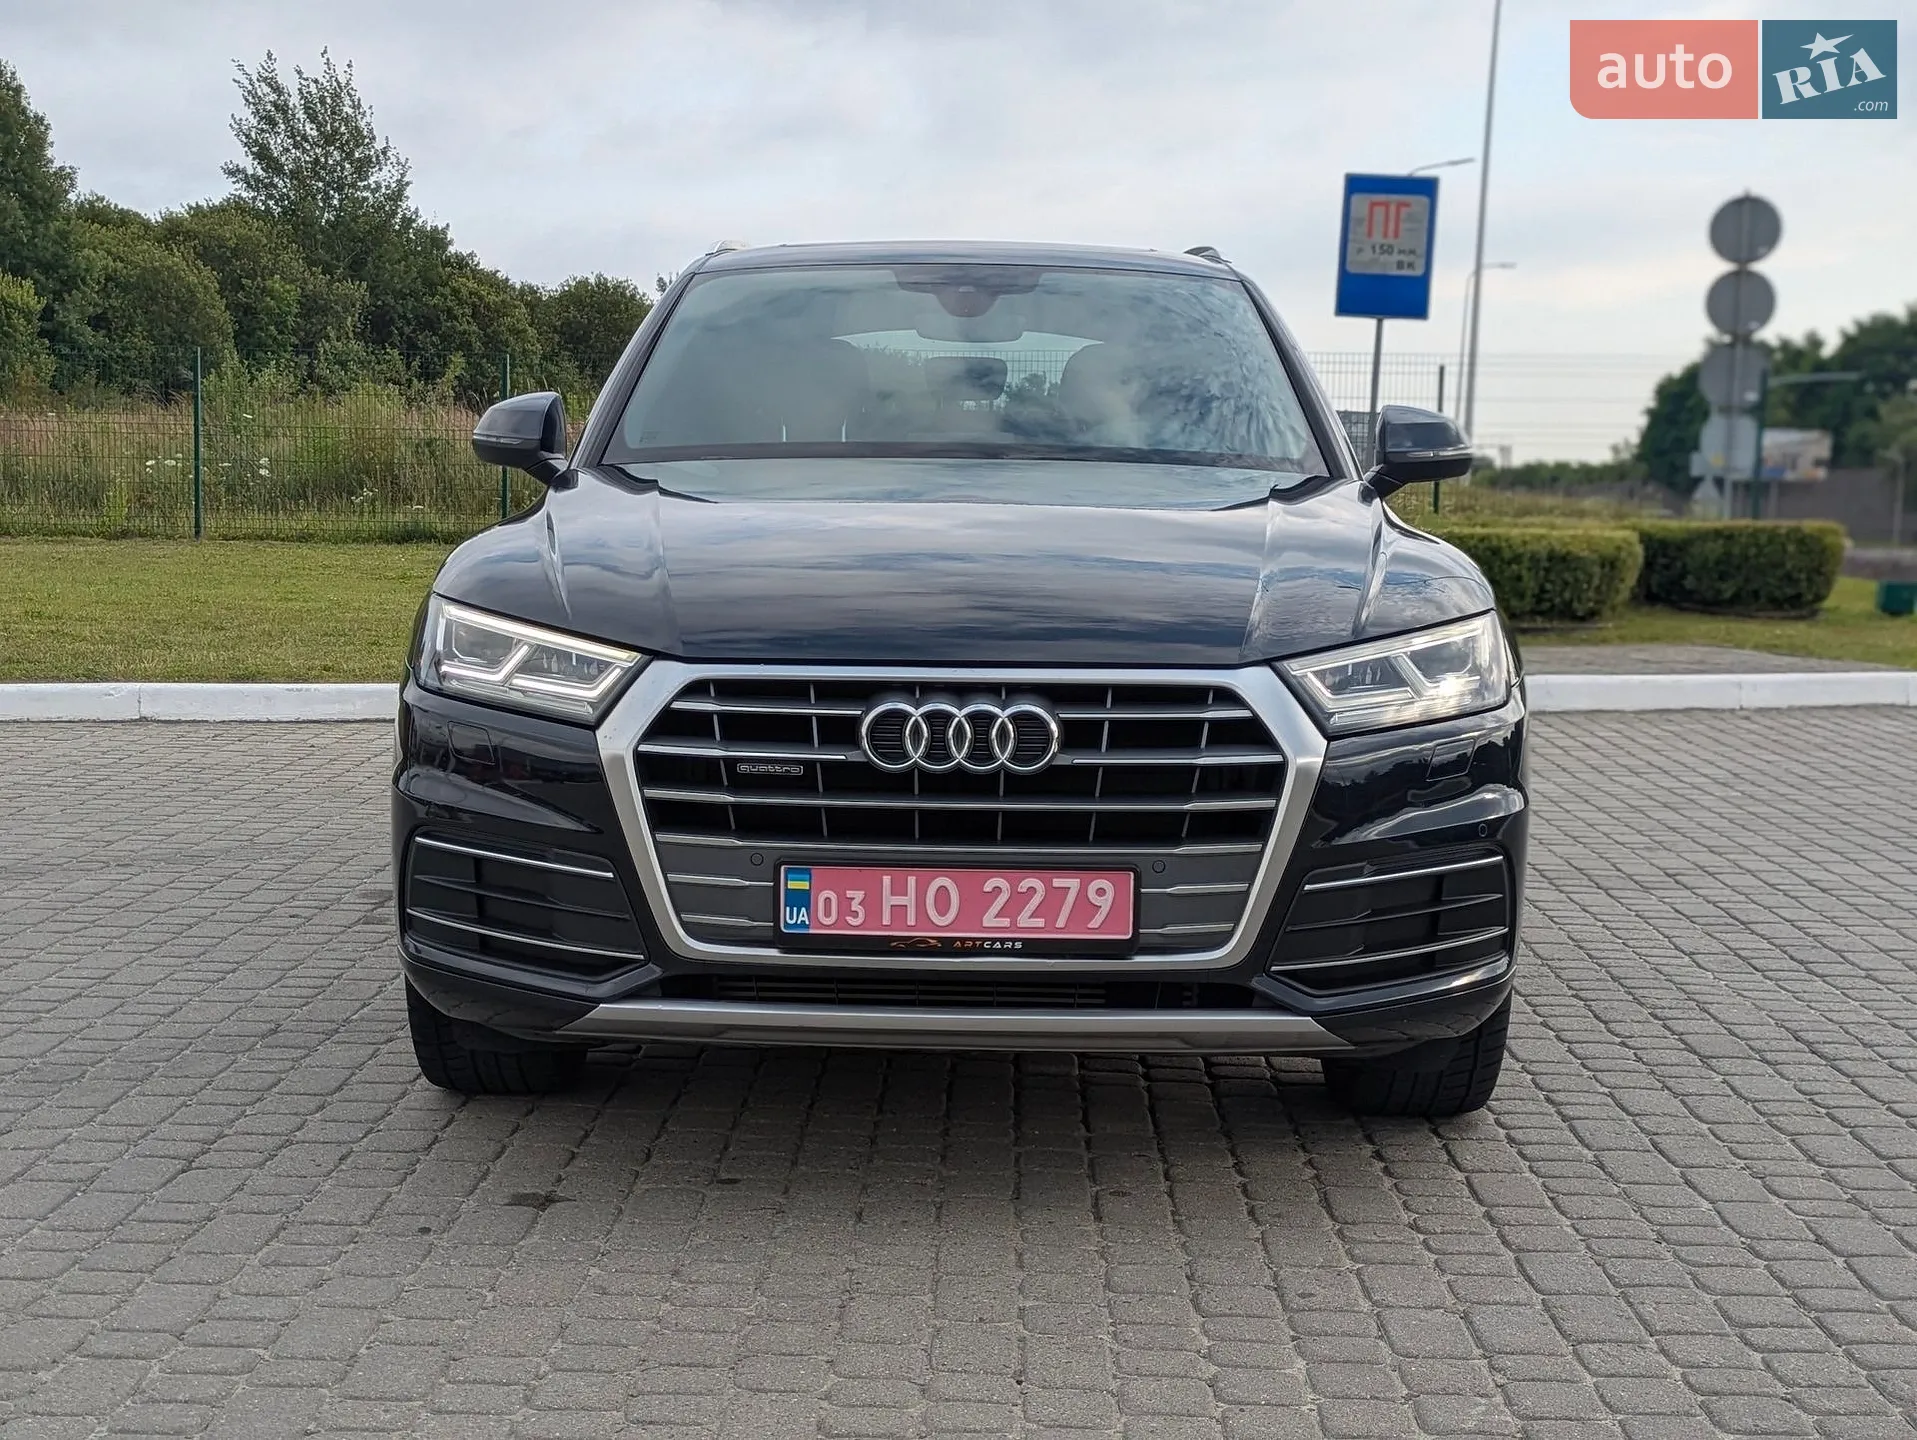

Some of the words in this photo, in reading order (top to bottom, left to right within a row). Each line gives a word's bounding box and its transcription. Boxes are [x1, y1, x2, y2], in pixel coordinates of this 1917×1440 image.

[1367, 201, 1411, 239] ПГ
[1370, 244, 1395, 256] 150
[740, 765, 800, 773] quattro
[817, 889, 867, 927] 03
[881, 875, 961, 928] HO
[982, 877, 1117, 930] 2279
[786, 906, 810, 926] UA
[952, 940, 1023, 950] ARTCARS
